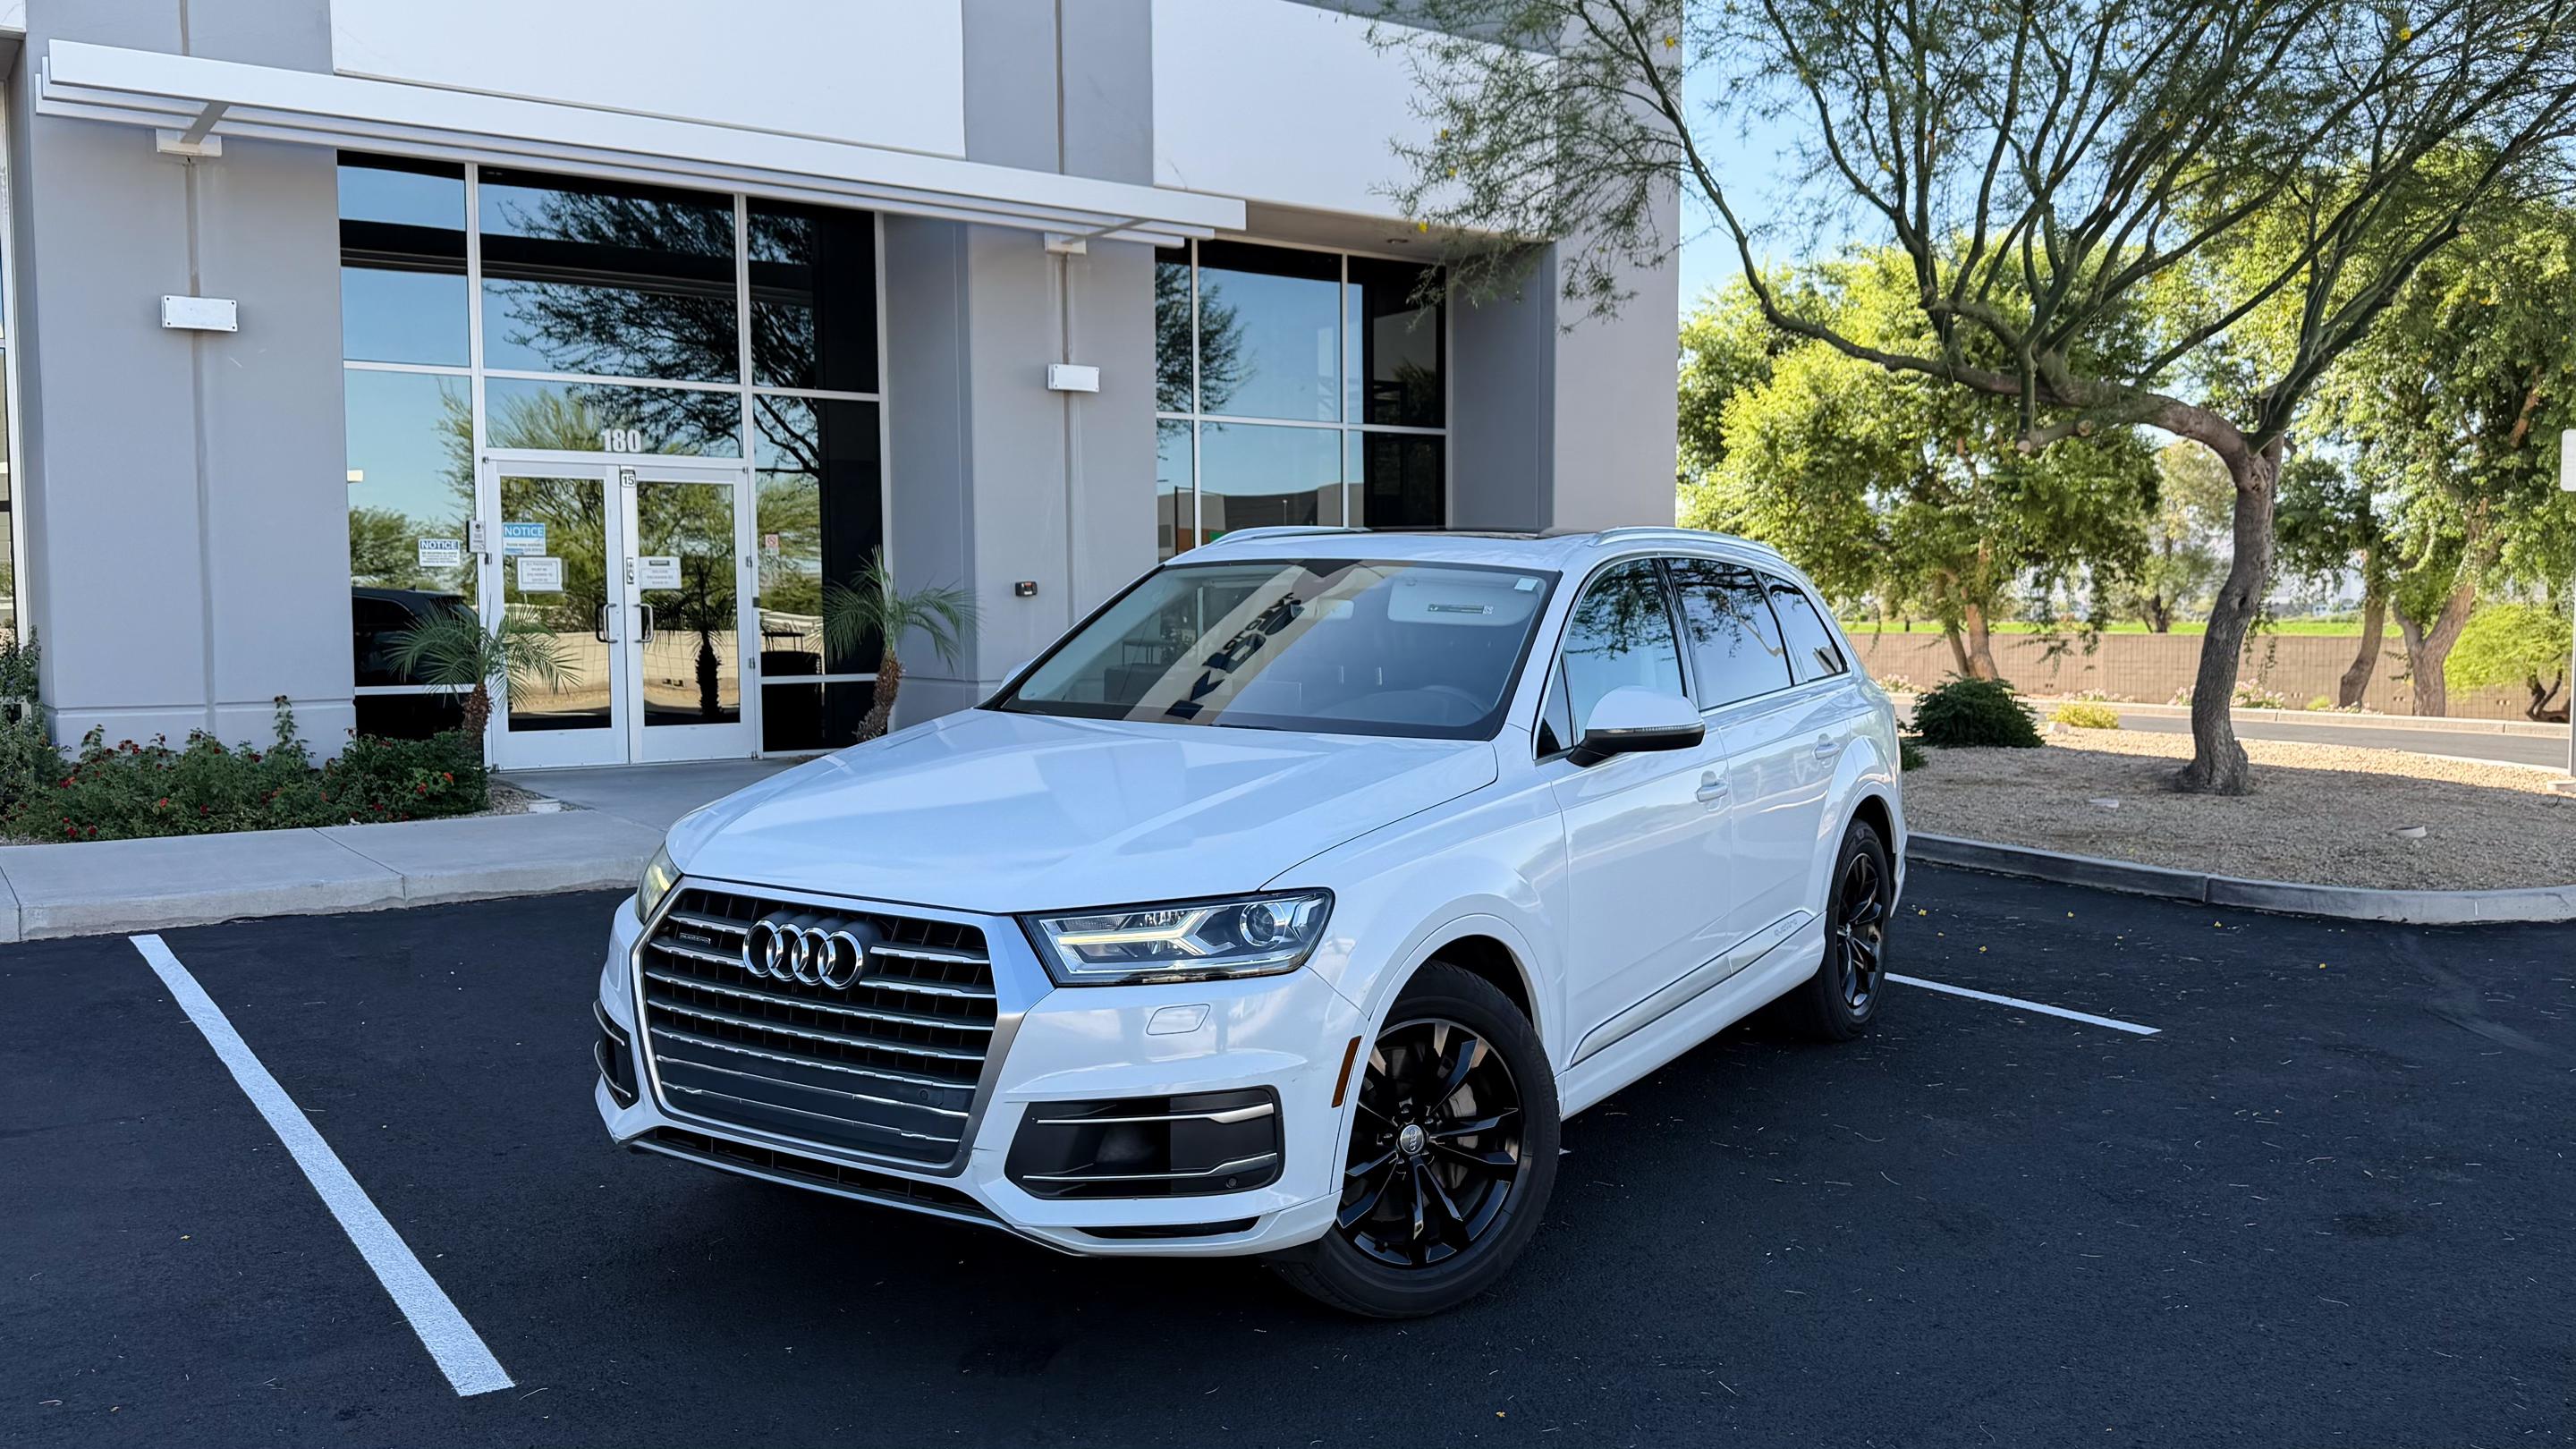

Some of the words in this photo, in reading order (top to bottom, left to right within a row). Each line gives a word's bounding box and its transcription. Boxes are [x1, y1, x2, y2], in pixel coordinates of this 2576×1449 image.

[601, 428, 641, 453] 180
[623, 475, 634, 485] 15
[504, 526, 544, 537] NOTICE
[421, 540, 457, 549] NOTICE
